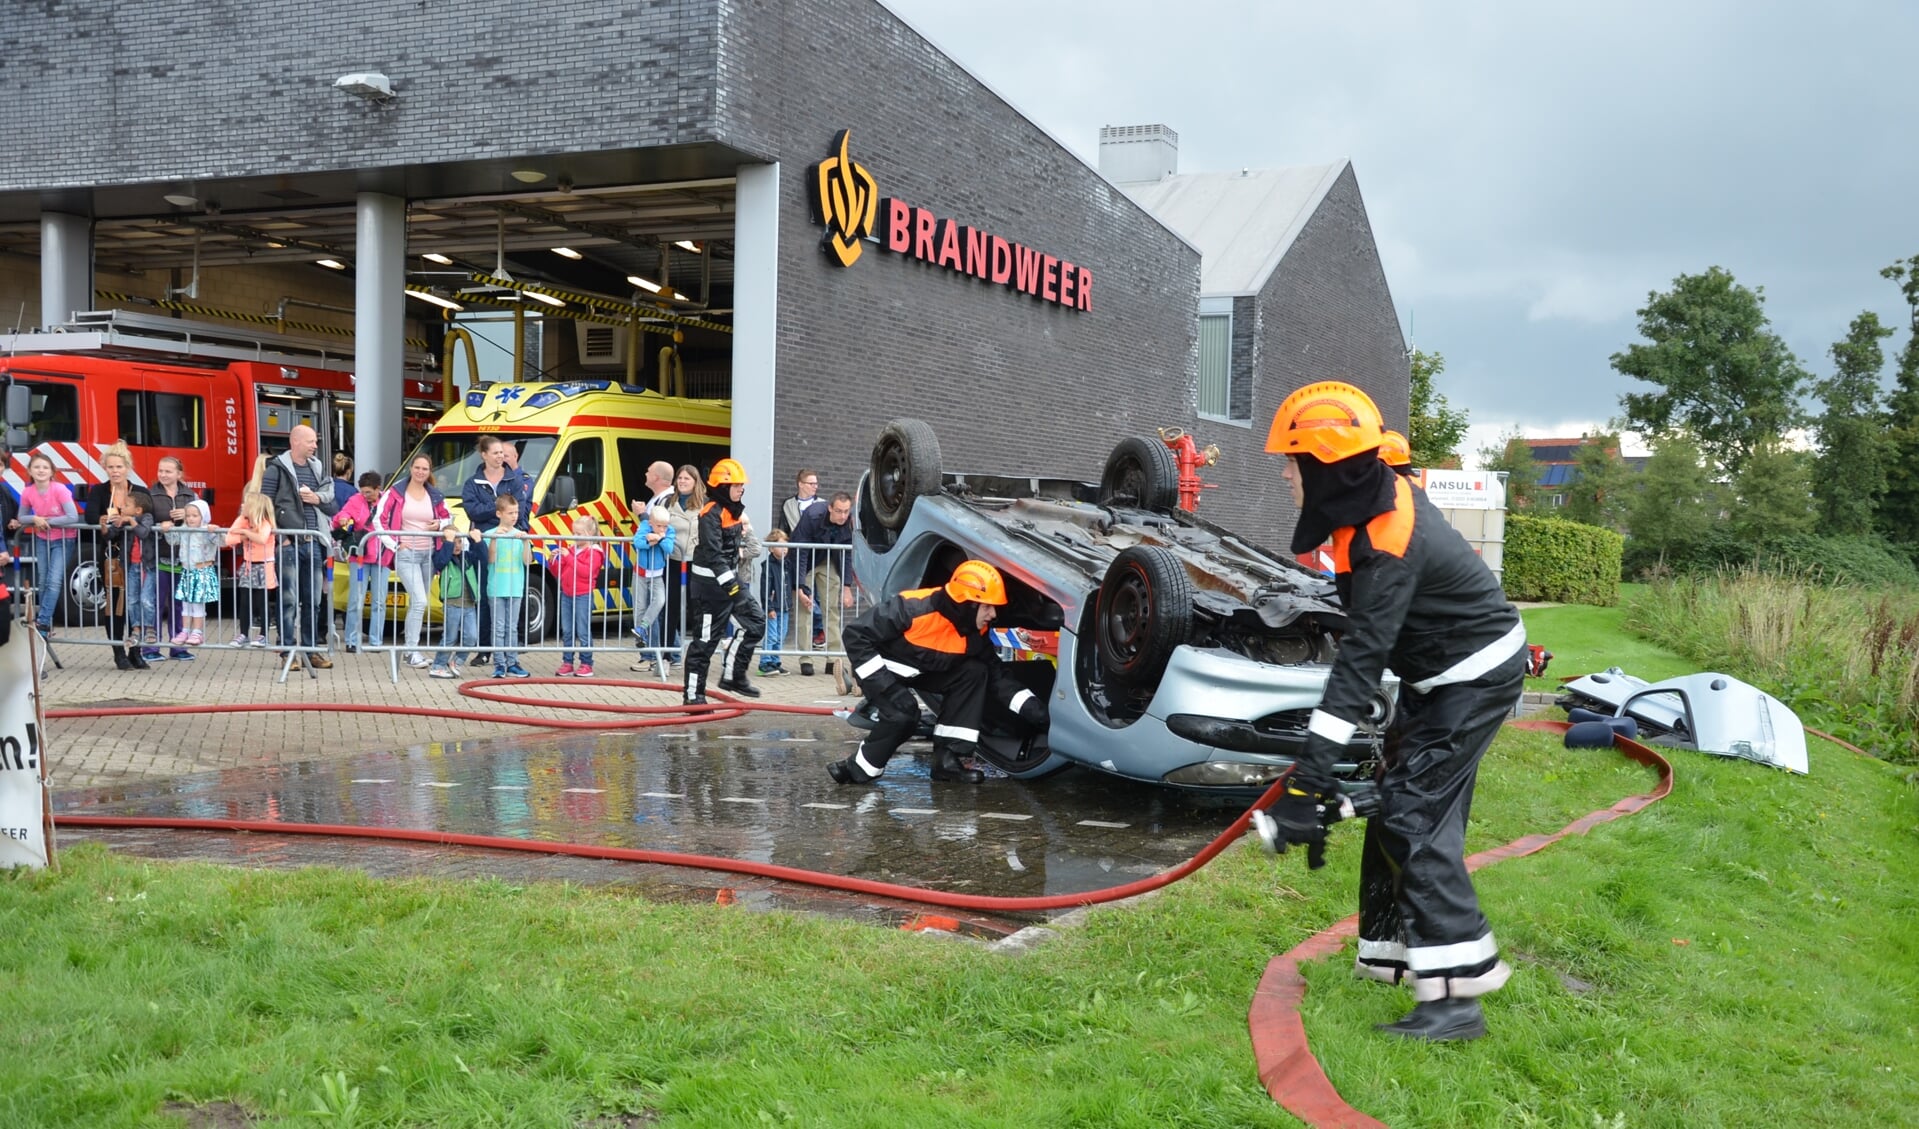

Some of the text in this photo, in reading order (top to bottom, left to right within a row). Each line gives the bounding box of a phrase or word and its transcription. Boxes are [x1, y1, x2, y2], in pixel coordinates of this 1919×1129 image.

[888, 197, 1093, 312] BRANDWEER
[225, 397, 238, 455] 16-3732
[184, 481, 207, 489] WEER
[1430, 481, 1472, 490] ANSUL
[0, 723, 38, 770] n!
